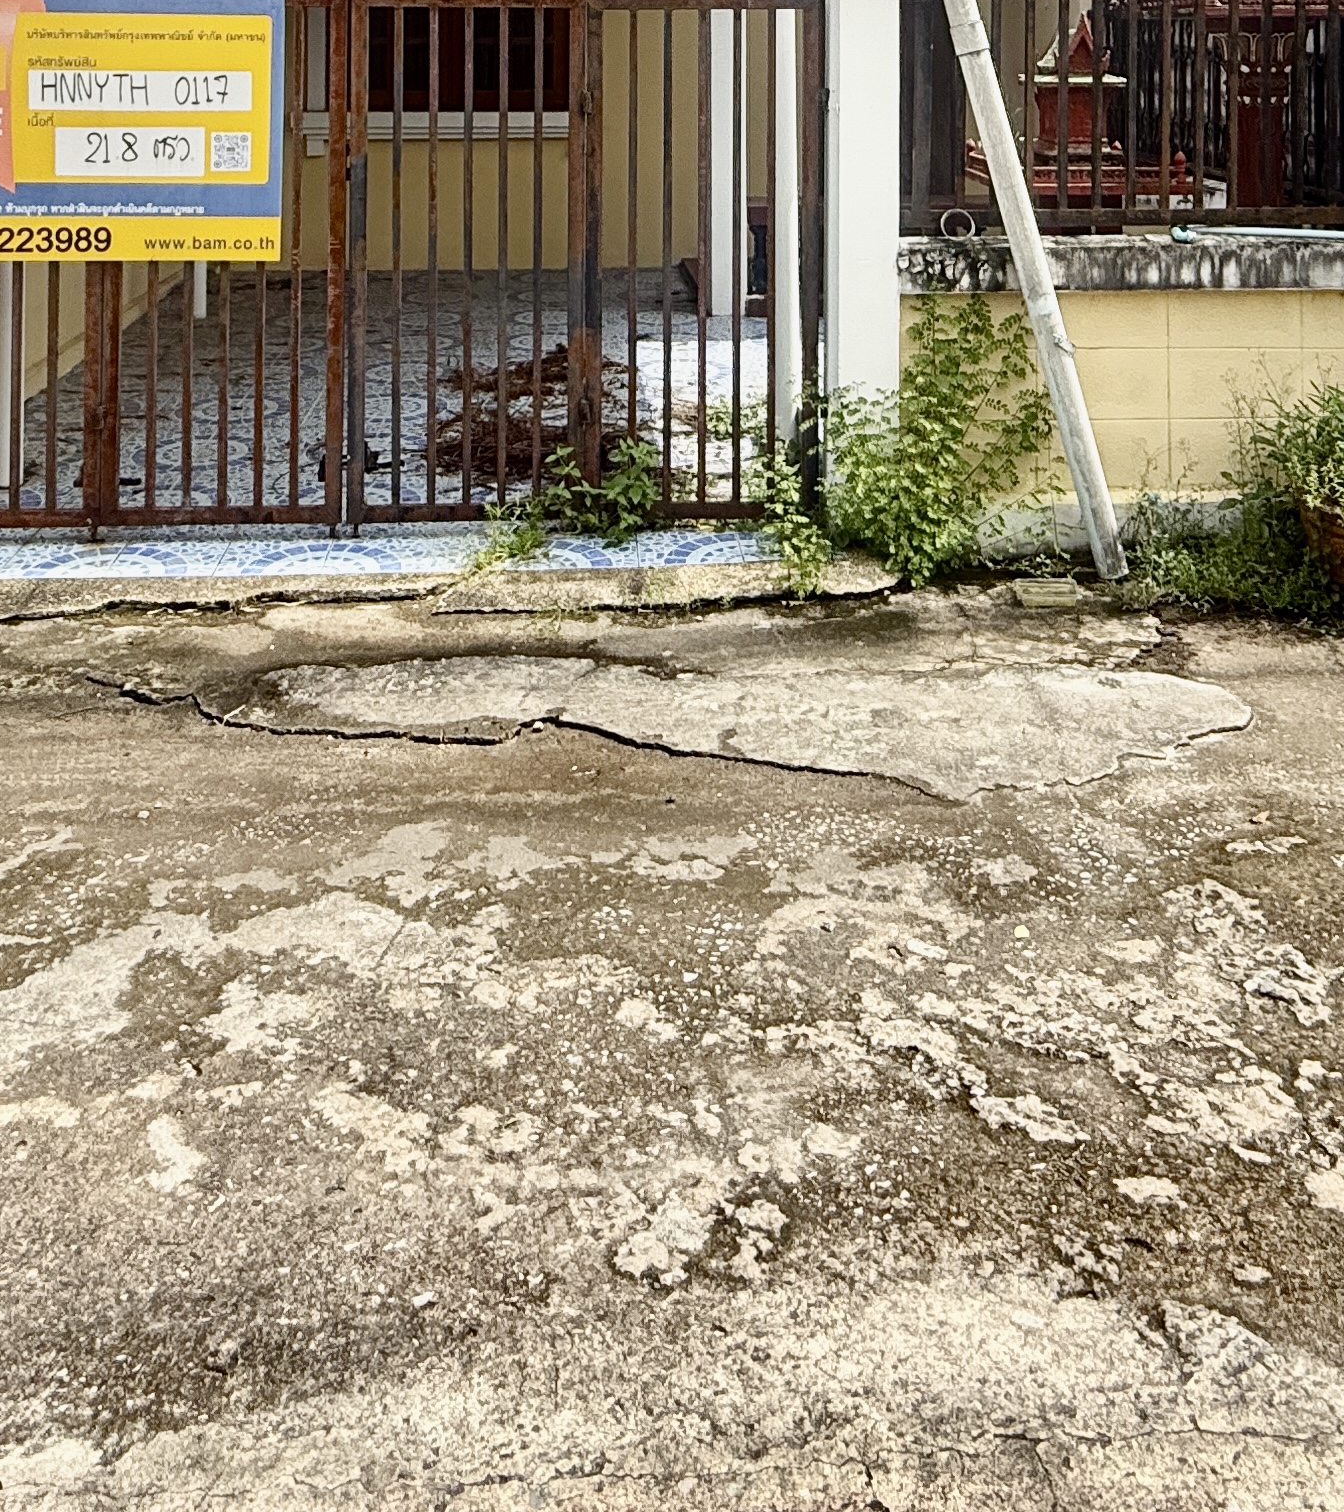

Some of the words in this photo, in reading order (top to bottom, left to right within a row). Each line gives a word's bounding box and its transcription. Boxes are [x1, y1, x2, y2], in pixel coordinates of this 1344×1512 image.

[27, 55, 97, 68] รหัสทรัพย์สิน
[41, 72, 149, 105] HNNYTH
[174, 75, 229, 105] 0117
[27, 112, 55, 127] เนื้อที่
[144, 236, 275, 250] www.bam.co.th
